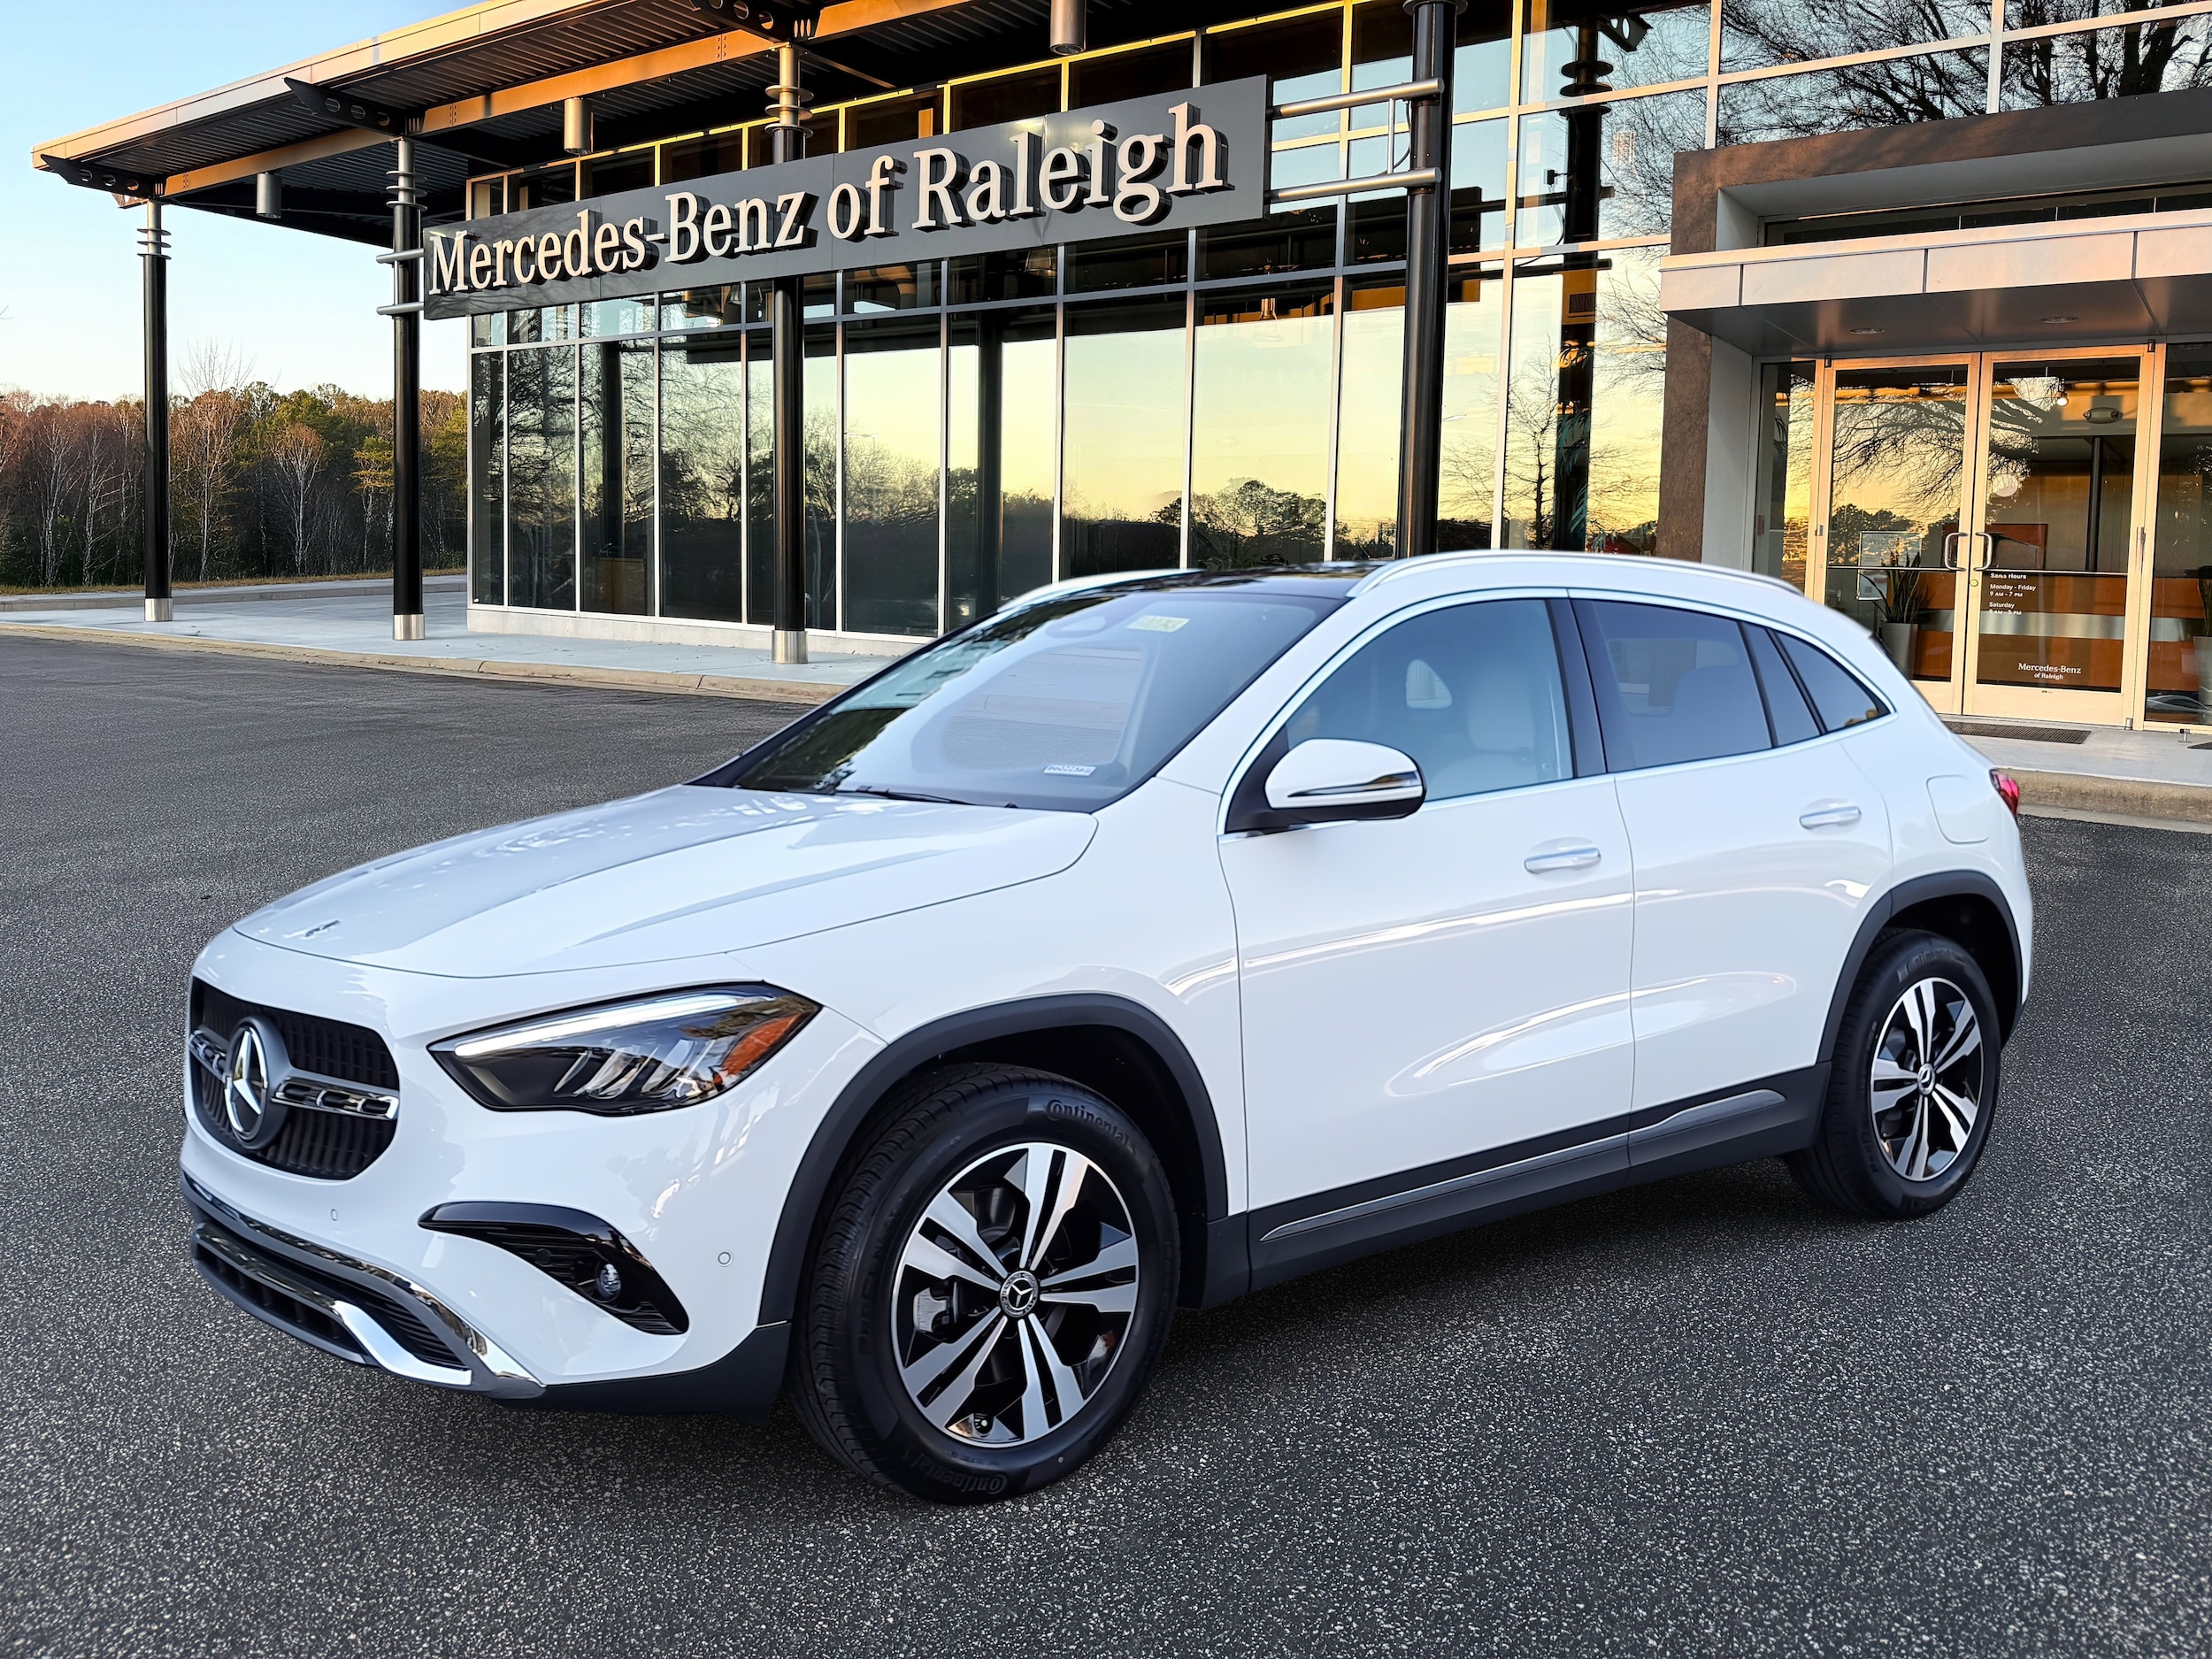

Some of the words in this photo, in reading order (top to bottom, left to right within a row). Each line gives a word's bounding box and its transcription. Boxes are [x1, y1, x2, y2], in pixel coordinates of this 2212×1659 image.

[428, 190, 807, 296] Mercedes-Benz
[826, 155, 898, 240] of
[911, 102, 1226, 223] Raleigh
[2018, 663, 2082, 674] Mercedes-Benz
[1045, 1099, 1131, 1146] Continental
